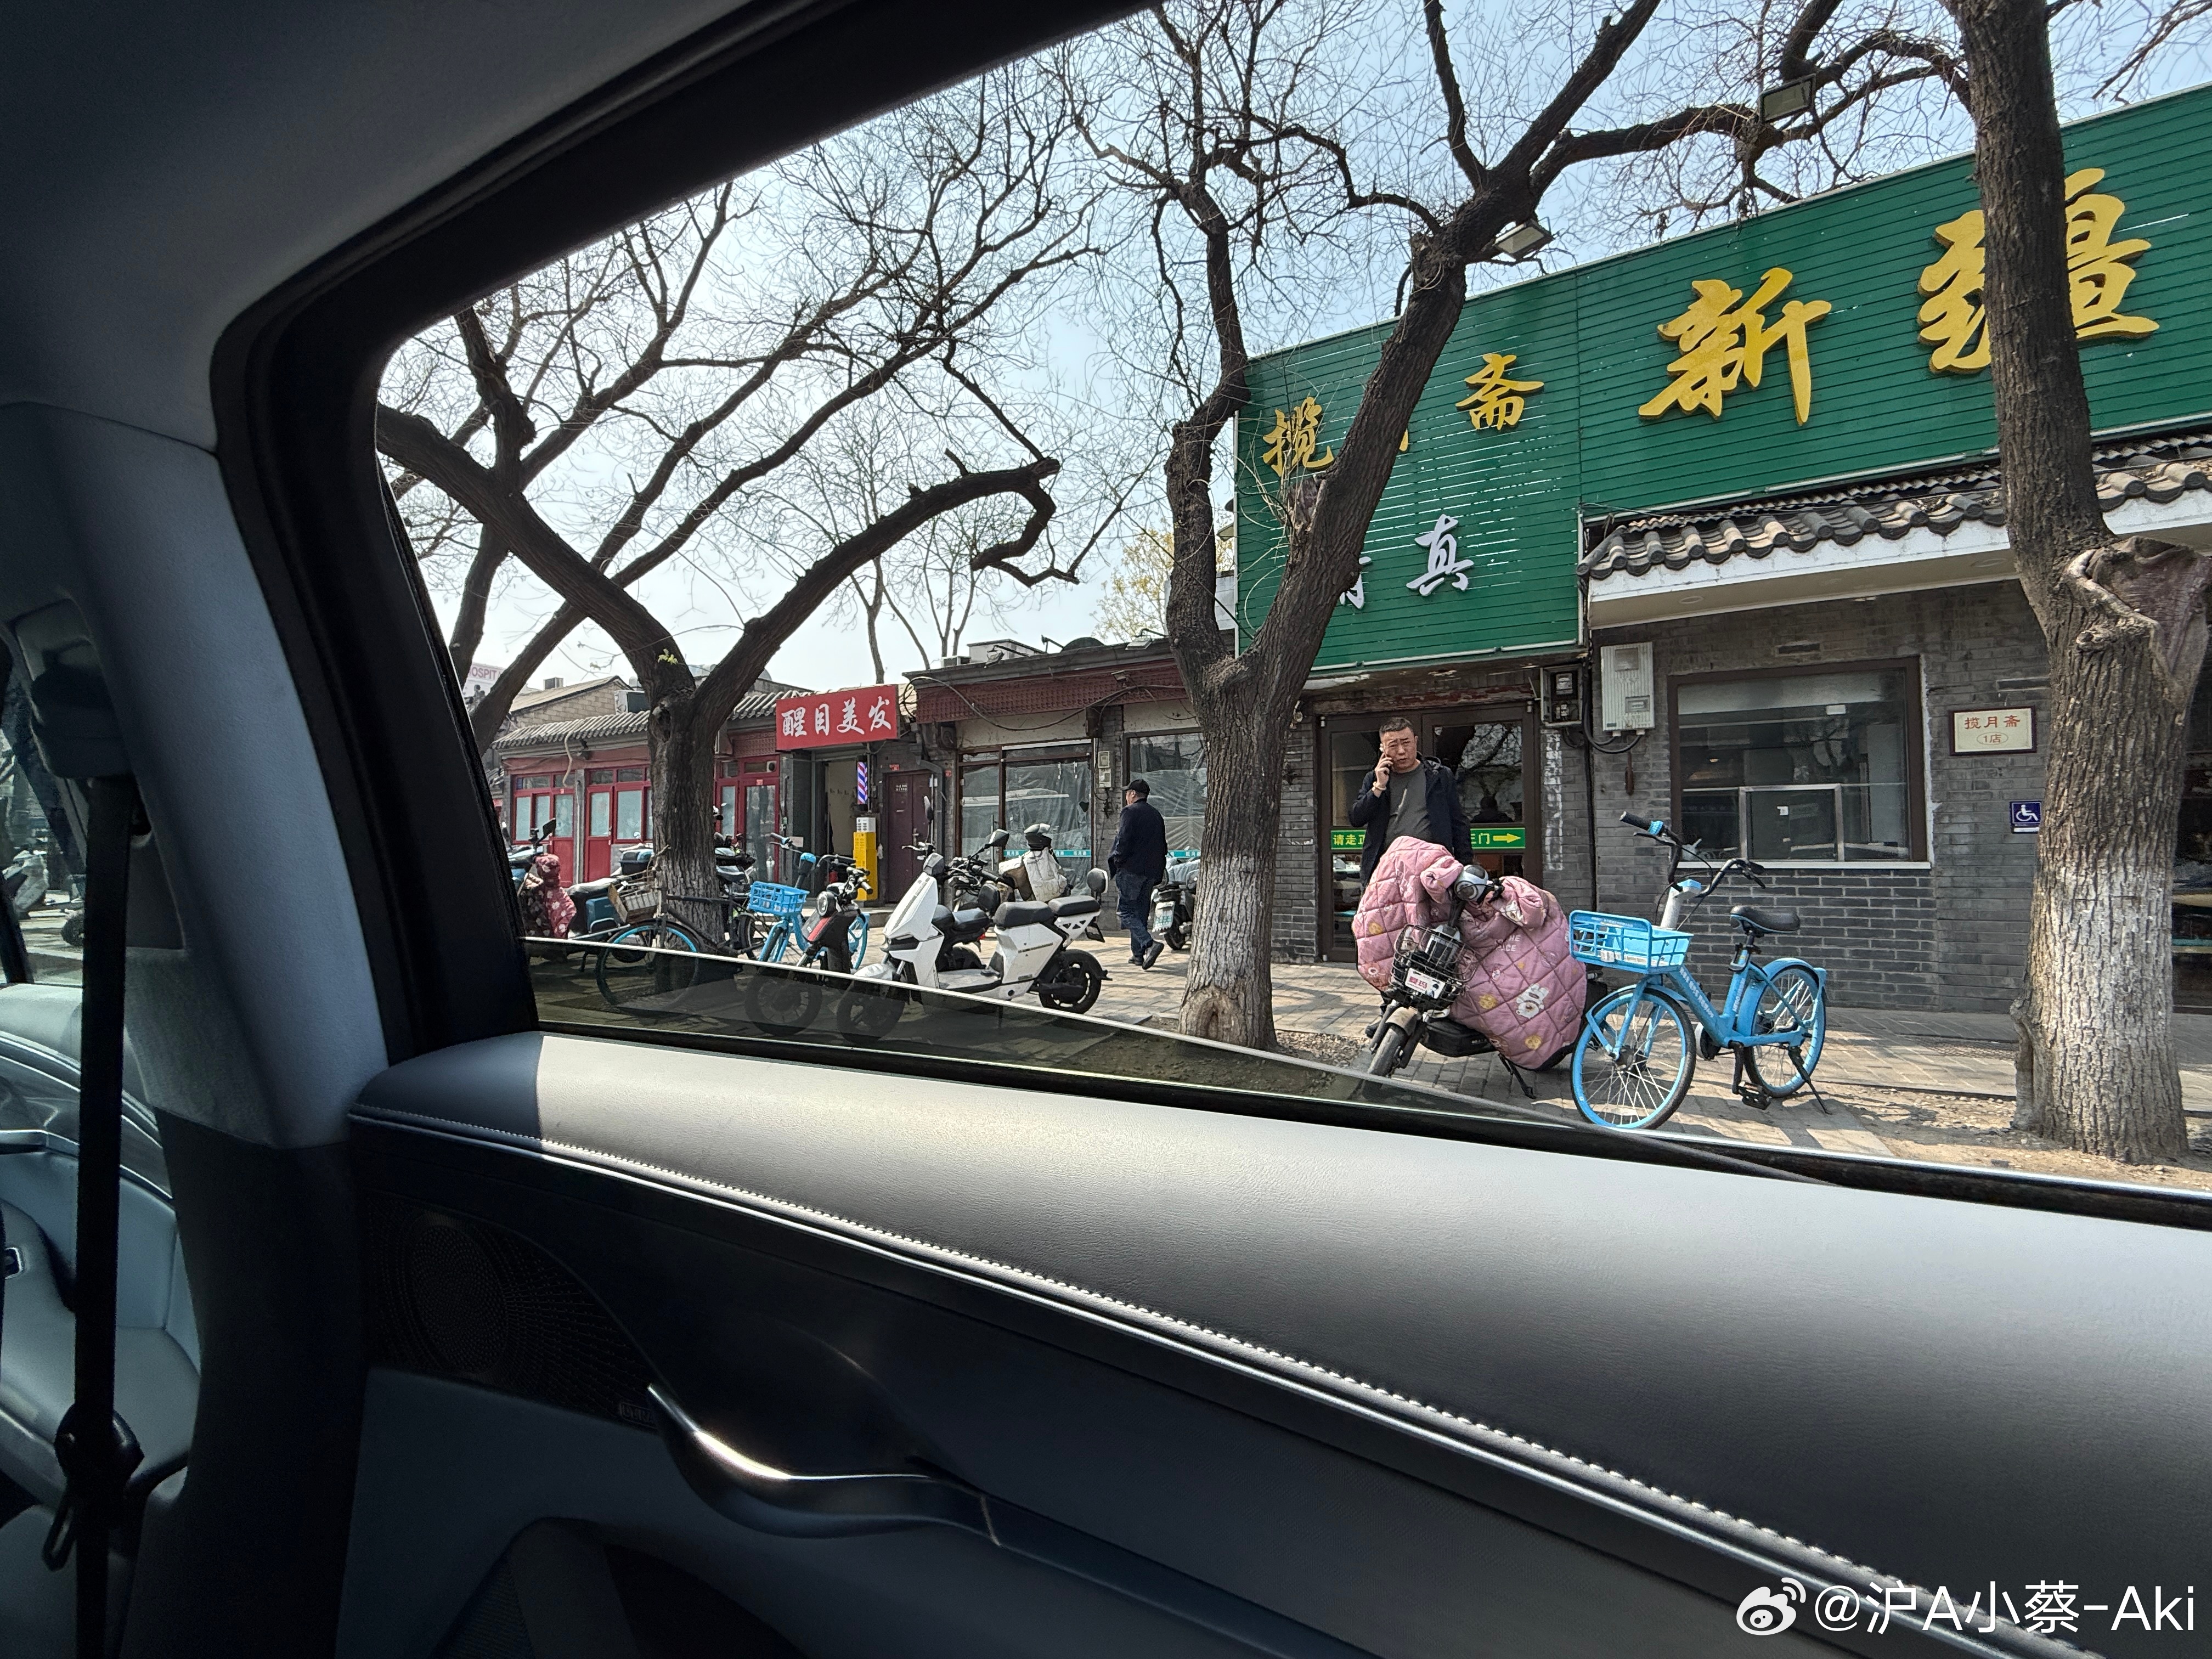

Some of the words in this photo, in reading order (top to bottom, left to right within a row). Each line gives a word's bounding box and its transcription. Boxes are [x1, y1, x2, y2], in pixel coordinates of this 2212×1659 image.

[470, 666, 501, 681] OSPIT
[781, 696, 891, 737] 醒目美发
[1965, 715, 2020, 730] 揽月斋
[1983, 734, 2001, 743] 1店
